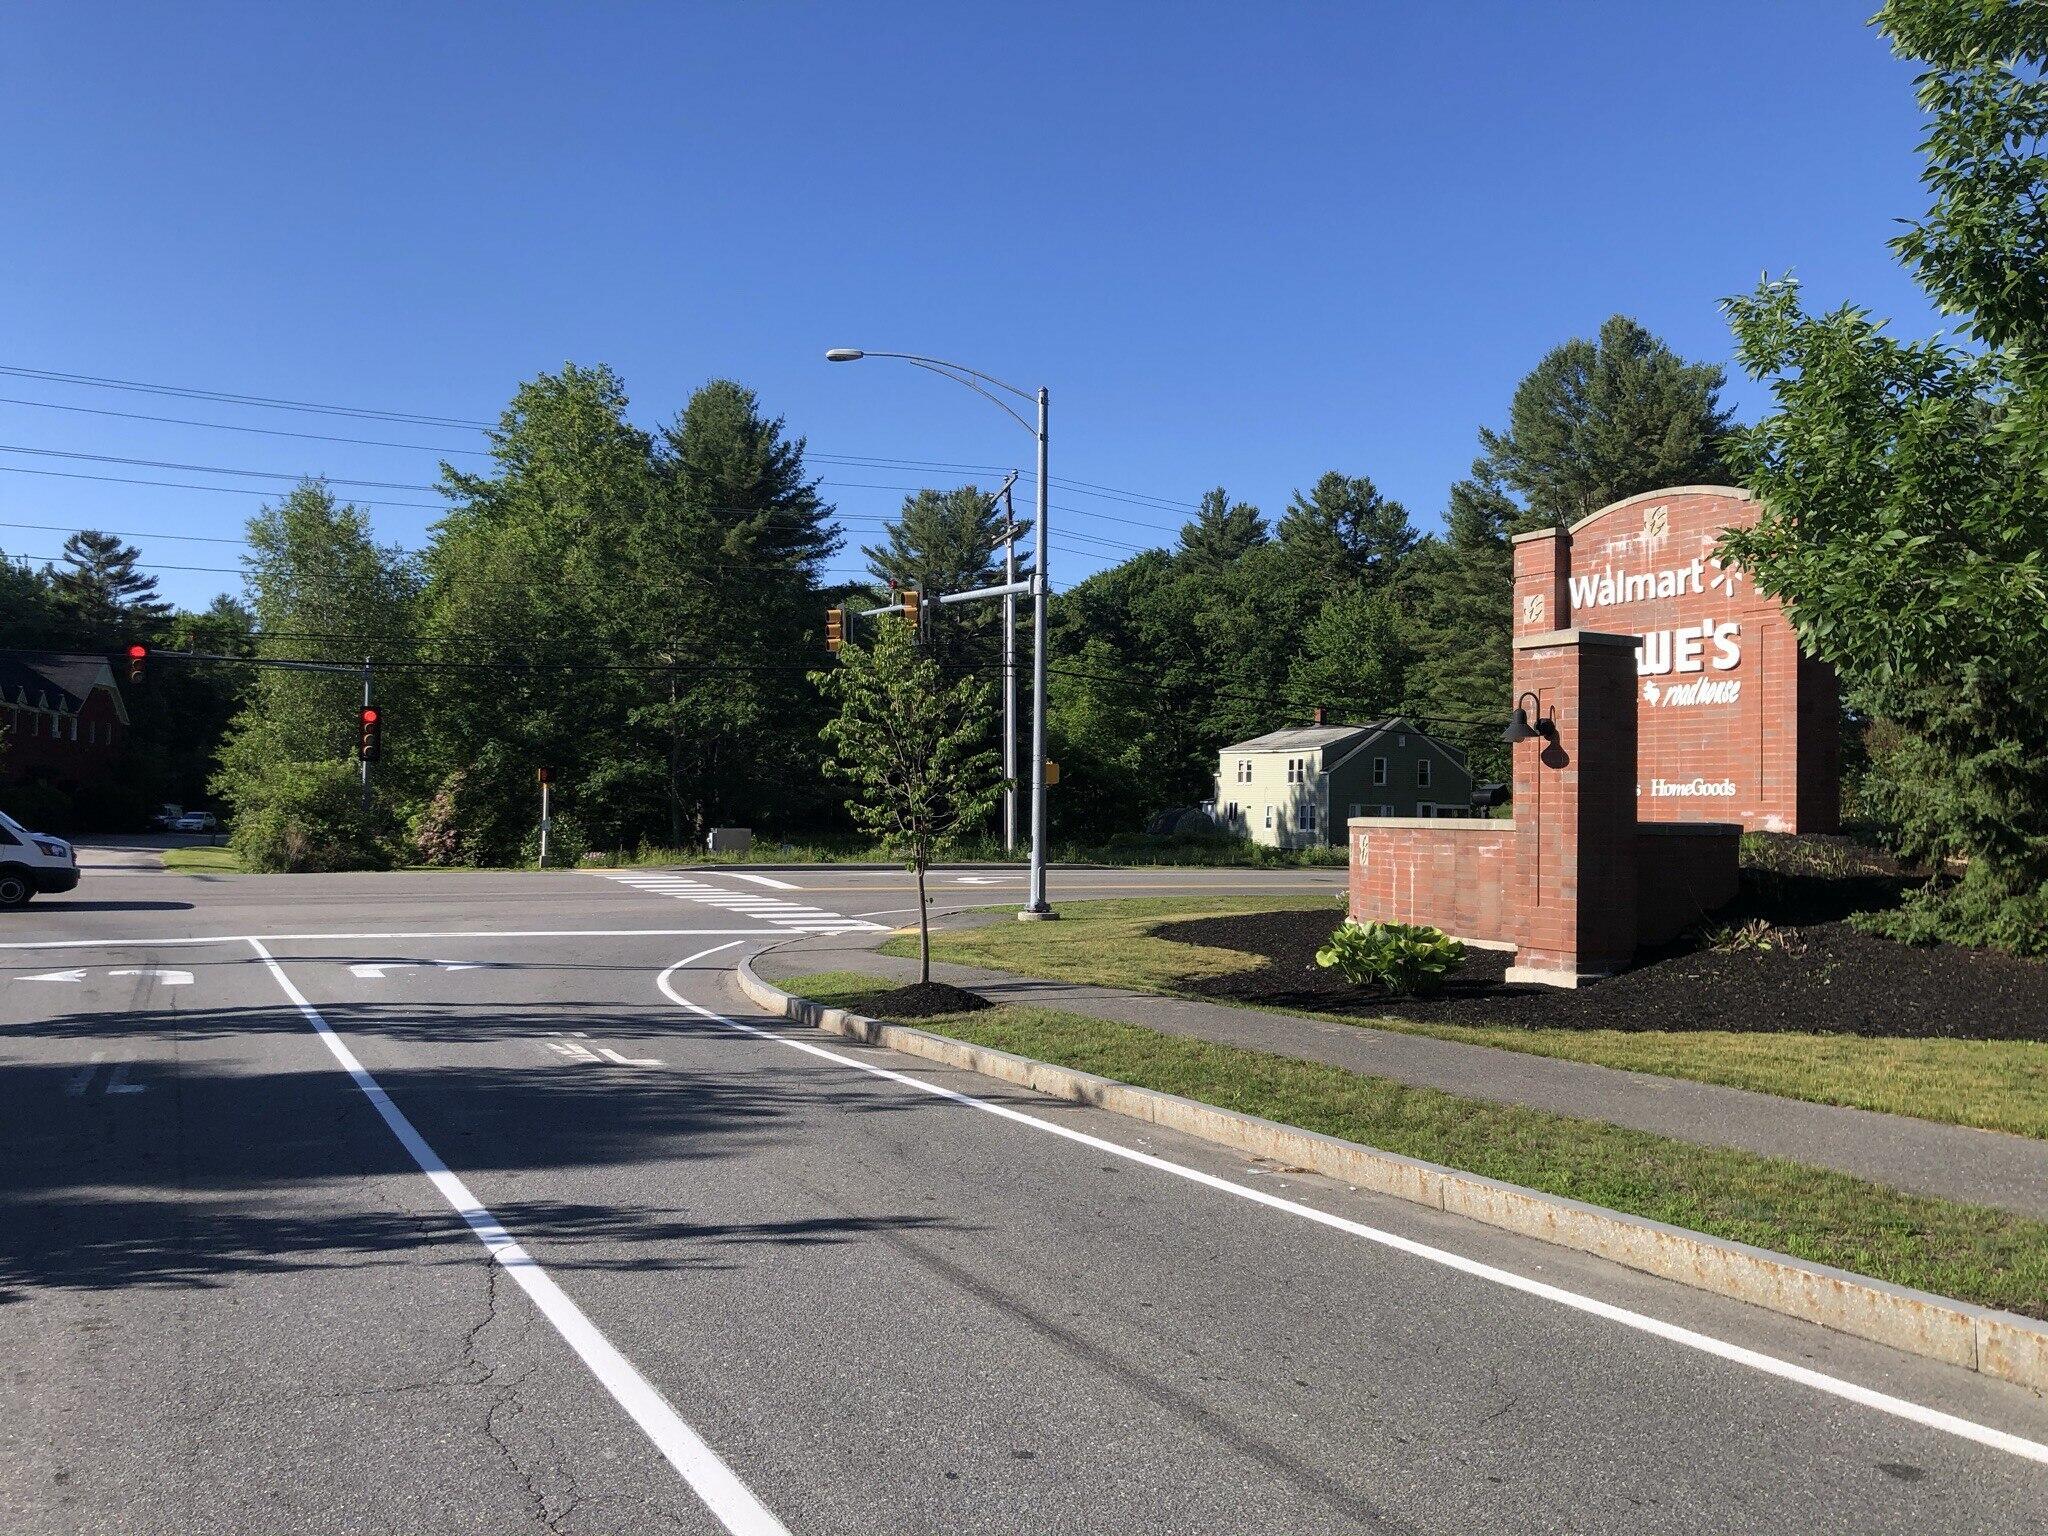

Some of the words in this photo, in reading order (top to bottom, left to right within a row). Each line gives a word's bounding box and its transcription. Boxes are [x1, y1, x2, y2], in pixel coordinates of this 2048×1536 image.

[1568, 558, 1705, 609] Walmart
[1635, 618, 1742, 676] WE'S
[1651, 778, 1737, 797] HomeGoods
